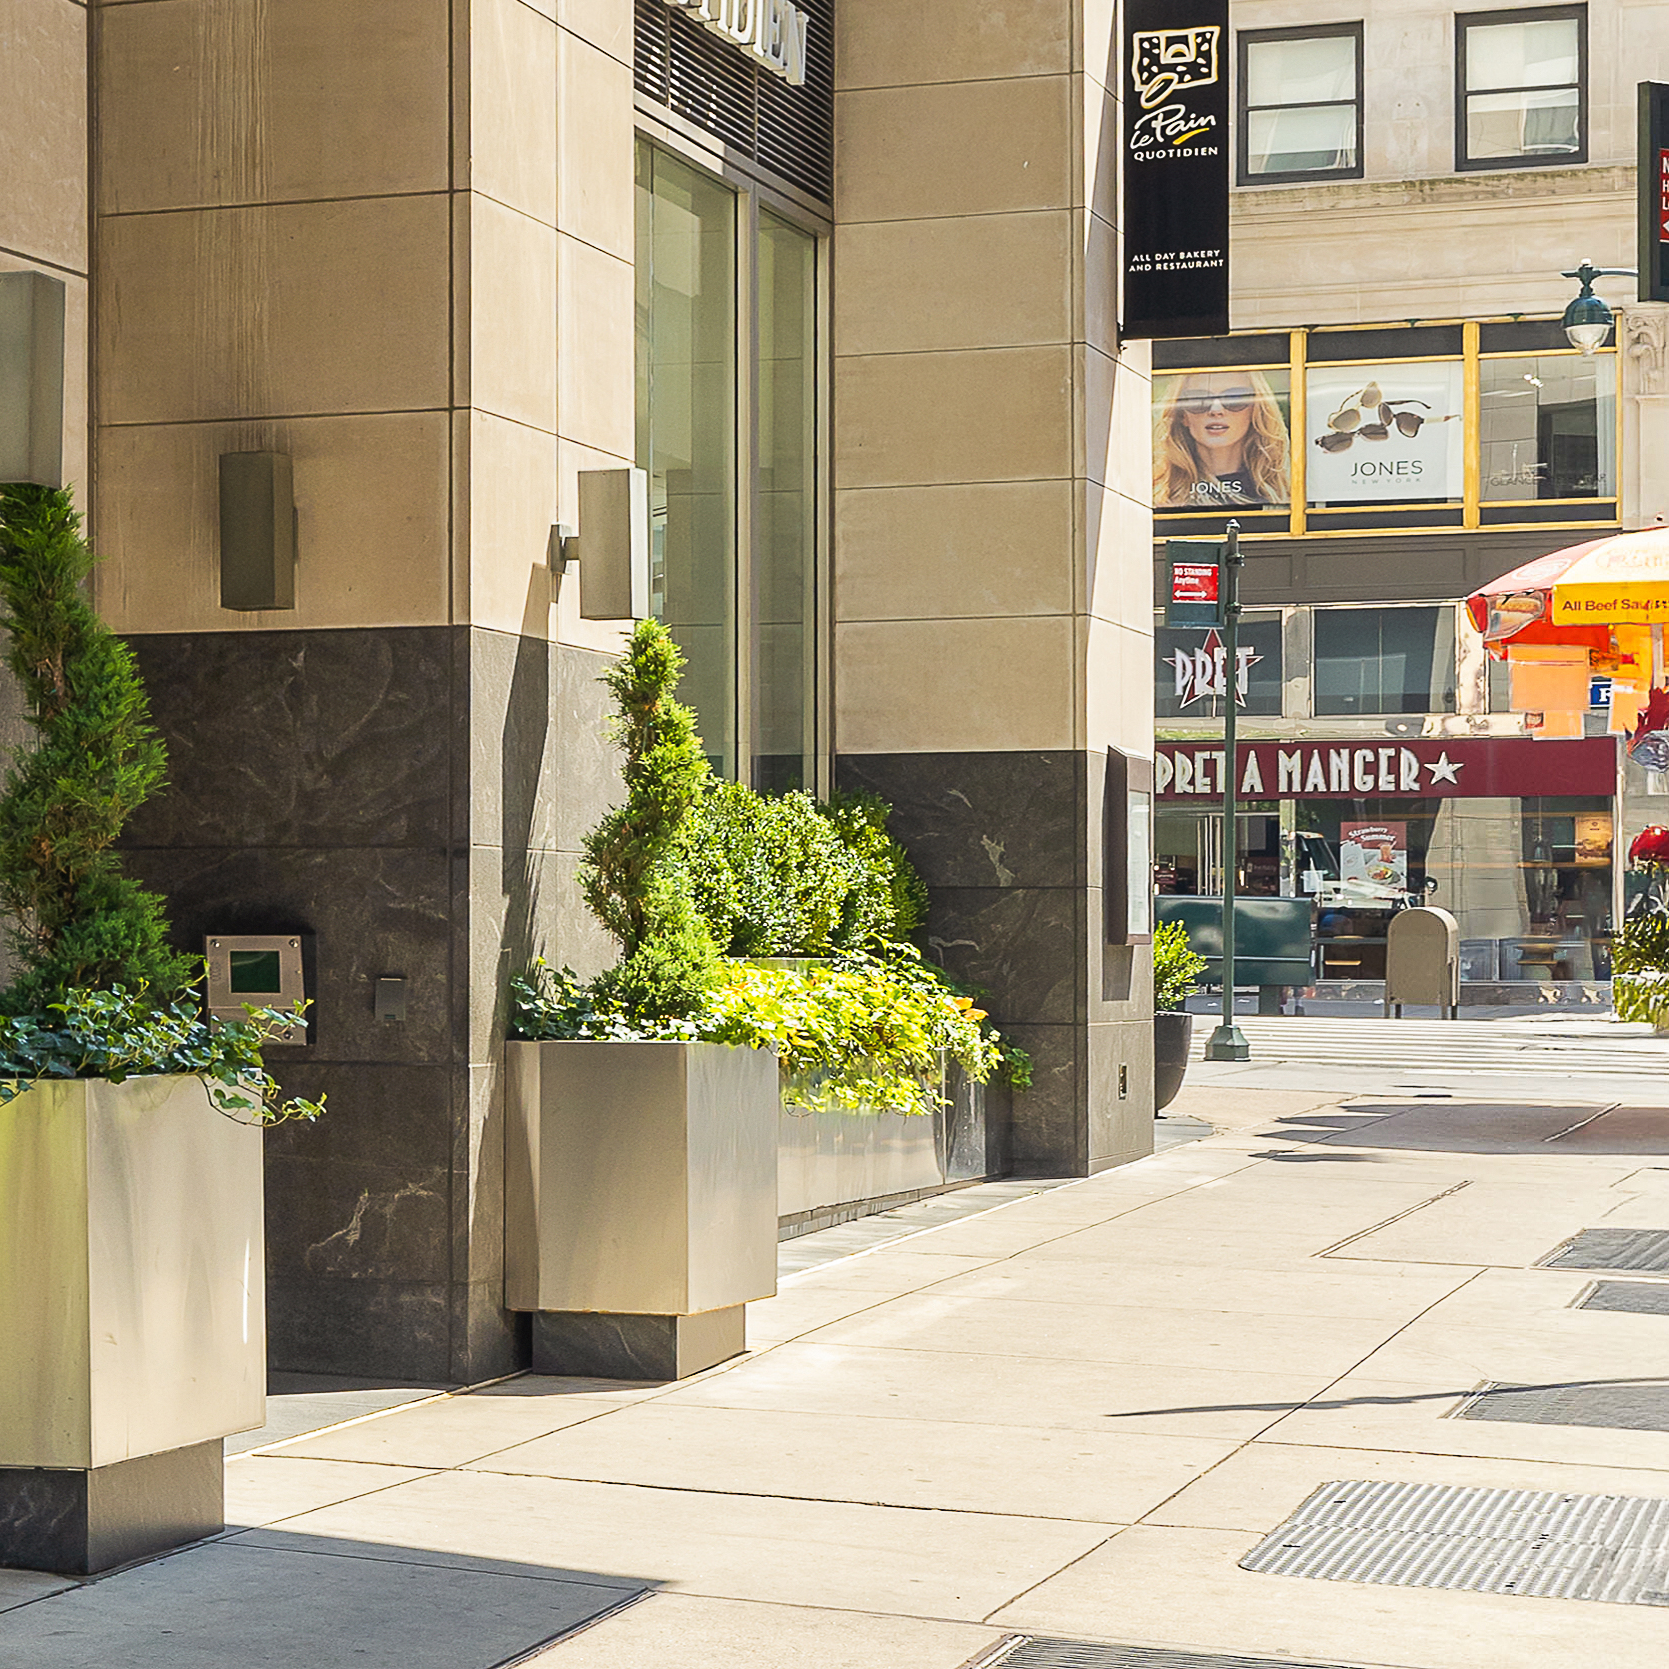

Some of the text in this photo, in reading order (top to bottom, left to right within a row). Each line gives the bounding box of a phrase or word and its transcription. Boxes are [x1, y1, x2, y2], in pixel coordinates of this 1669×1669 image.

[1134, 104, 1216, 142] Pain
[1134, 147, 1218, 162] QUOTIDIEN
[1132, 250, 1220, 262] ALL DAY BAKERY
[1129, 259, 1224, 272] AND RESTAURANT
[1351, 460, 1423, 476] JONES
[1189, 481, 1242, 494] JONES
[1174, 567, 1213, 577] NO STANDING
[1174, 576, 1200, 586] Anytime
[1562, 600, 1581, 611] All
[1585, 598, 1618, 611] Beef
[1175, 646, 1254, 696] PRET
[1155, 747, 1421, 794] PRET A MANGER
